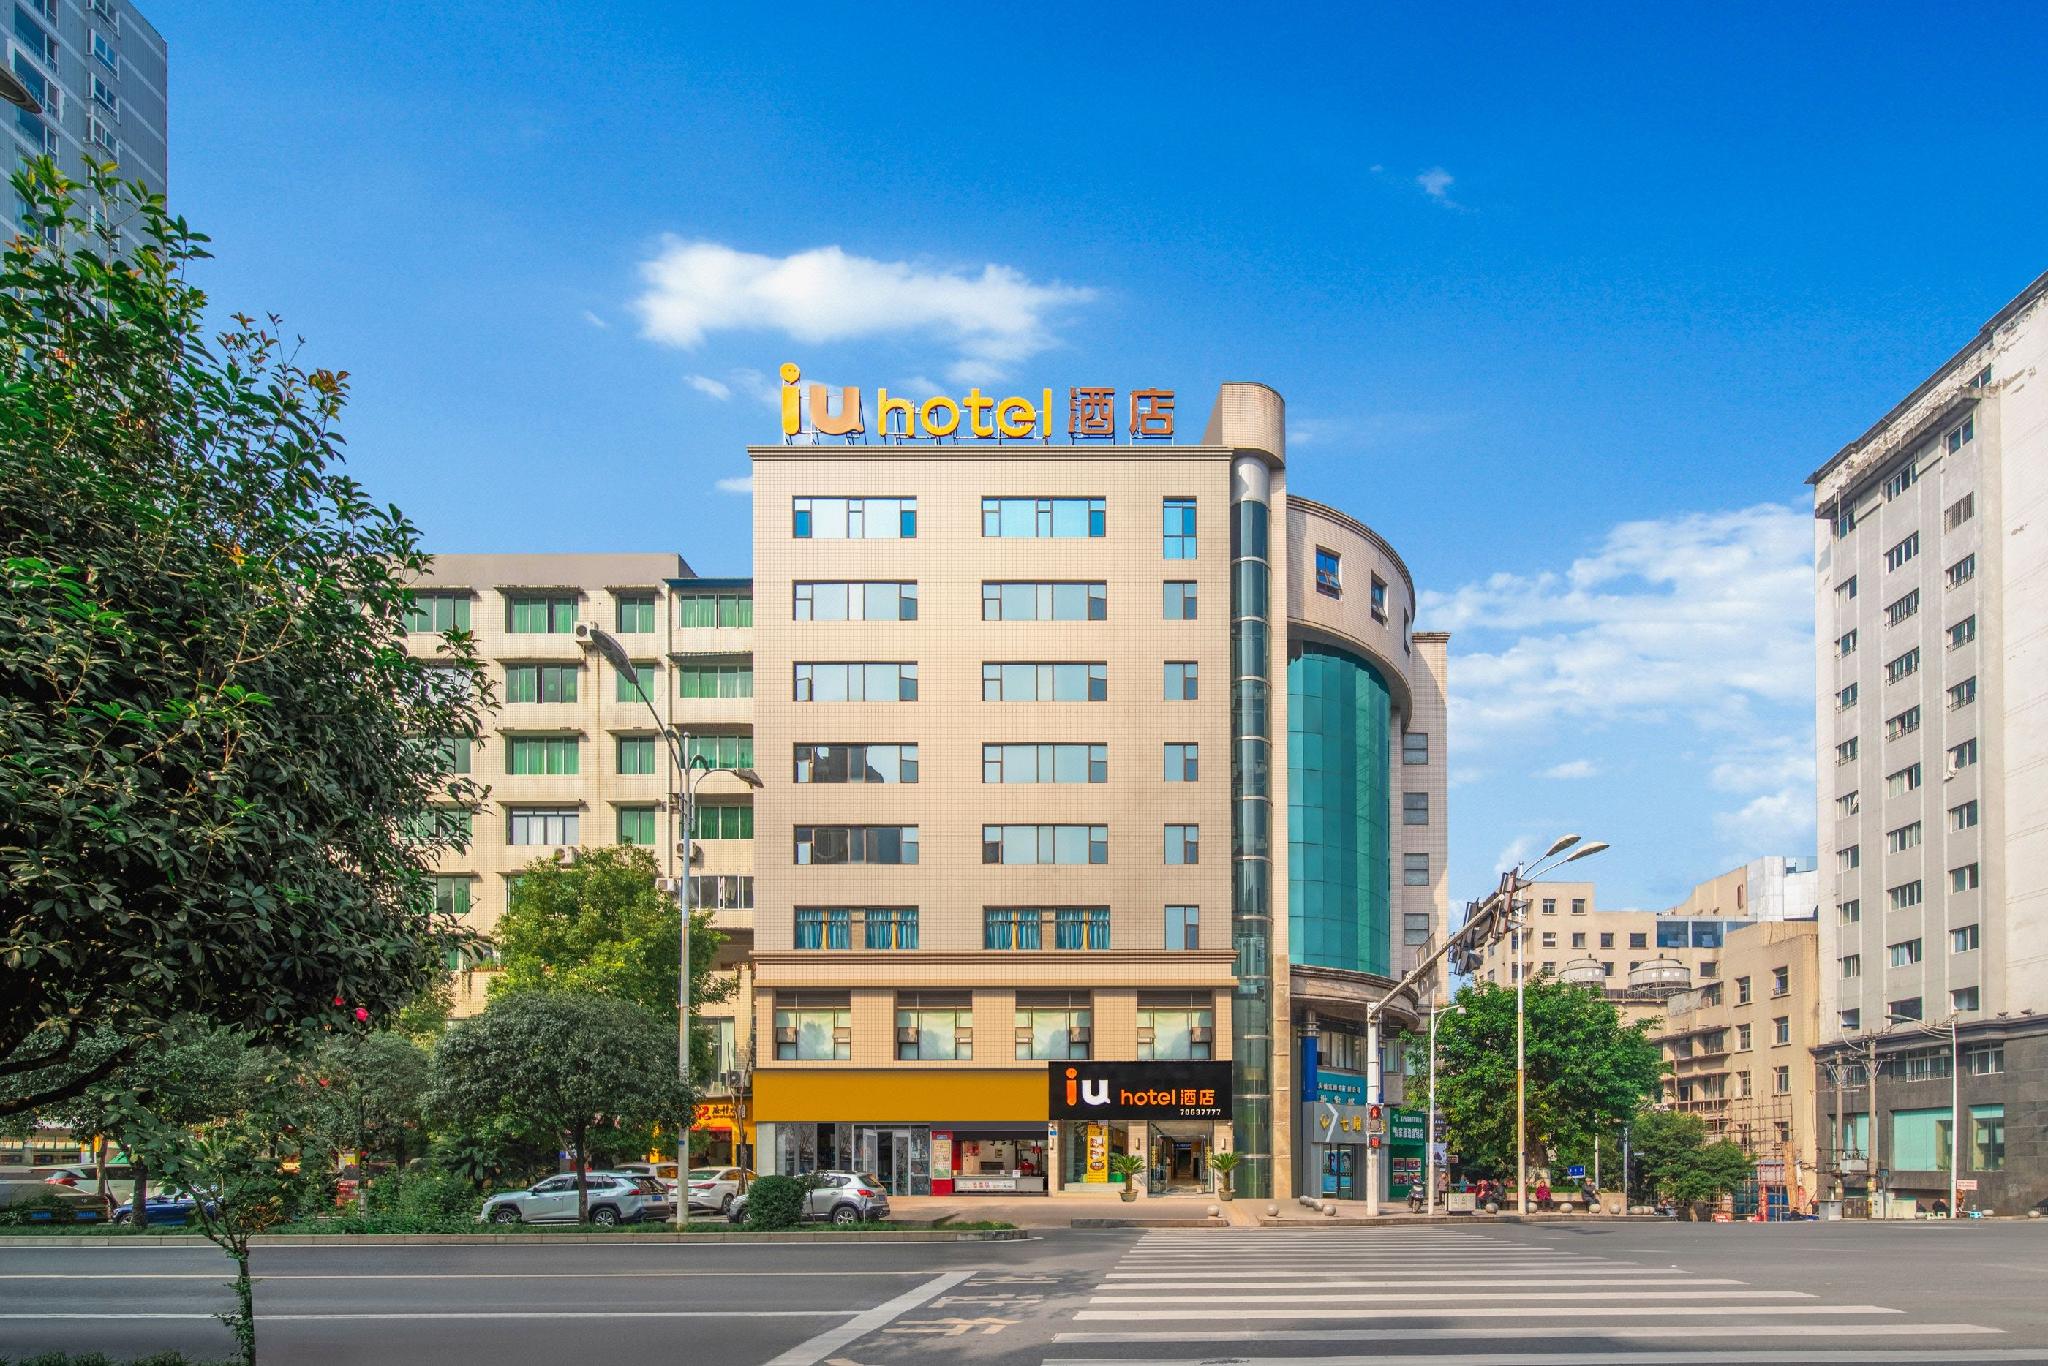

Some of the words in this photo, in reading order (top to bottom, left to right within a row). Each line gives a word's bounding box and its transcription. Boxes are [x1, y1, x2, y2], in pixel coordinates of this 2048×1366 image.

[780, 362, 865, 435] iu
[877, 387, 1052, 438] hotel
[1068, 386, 1175, 435] 酒店
[1065, 1067, 1111, 1106] iu
[1120, 1088, 1176, 1106] hotel
[1180, 1088, 1215, 1106] 酒店
